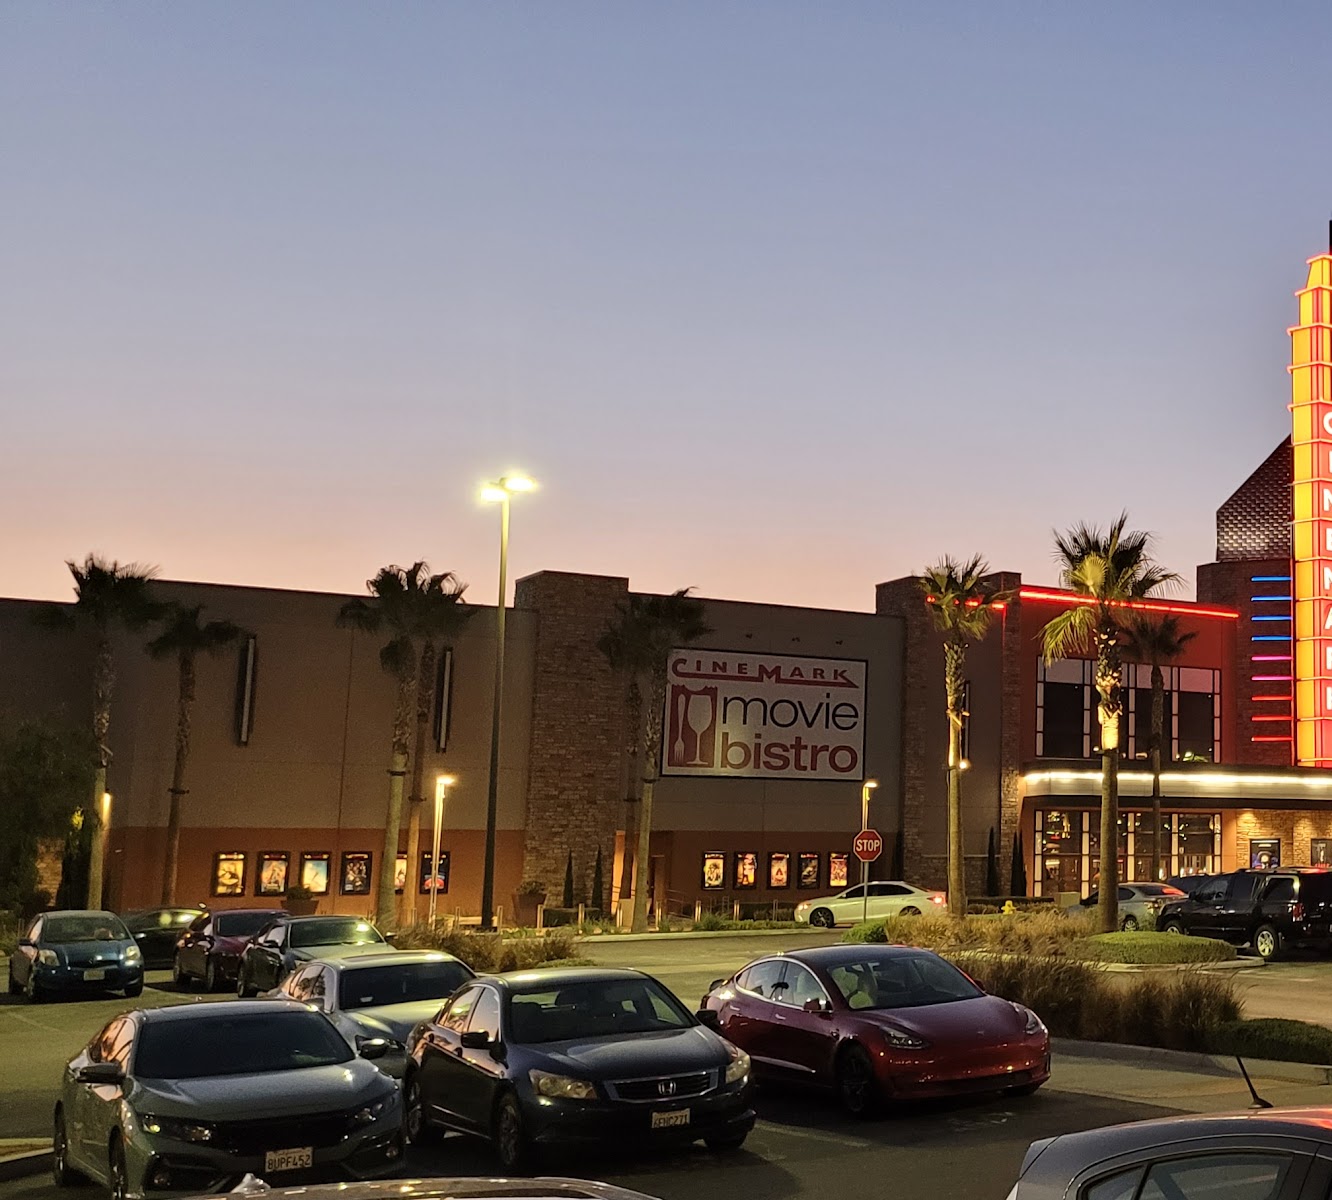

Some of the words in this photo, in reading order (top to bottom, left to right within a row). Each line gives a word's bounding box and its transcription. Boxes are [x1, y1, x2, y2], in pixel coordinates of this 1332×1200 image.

[671, 658, 859, 688] CINEMARK
[723, 693, 858, 730] movie
[721, 732, 857, 772] bistro
[856, 839, 880, 851] STOP
[267, 1155, 311, 1170] 8UPF452
